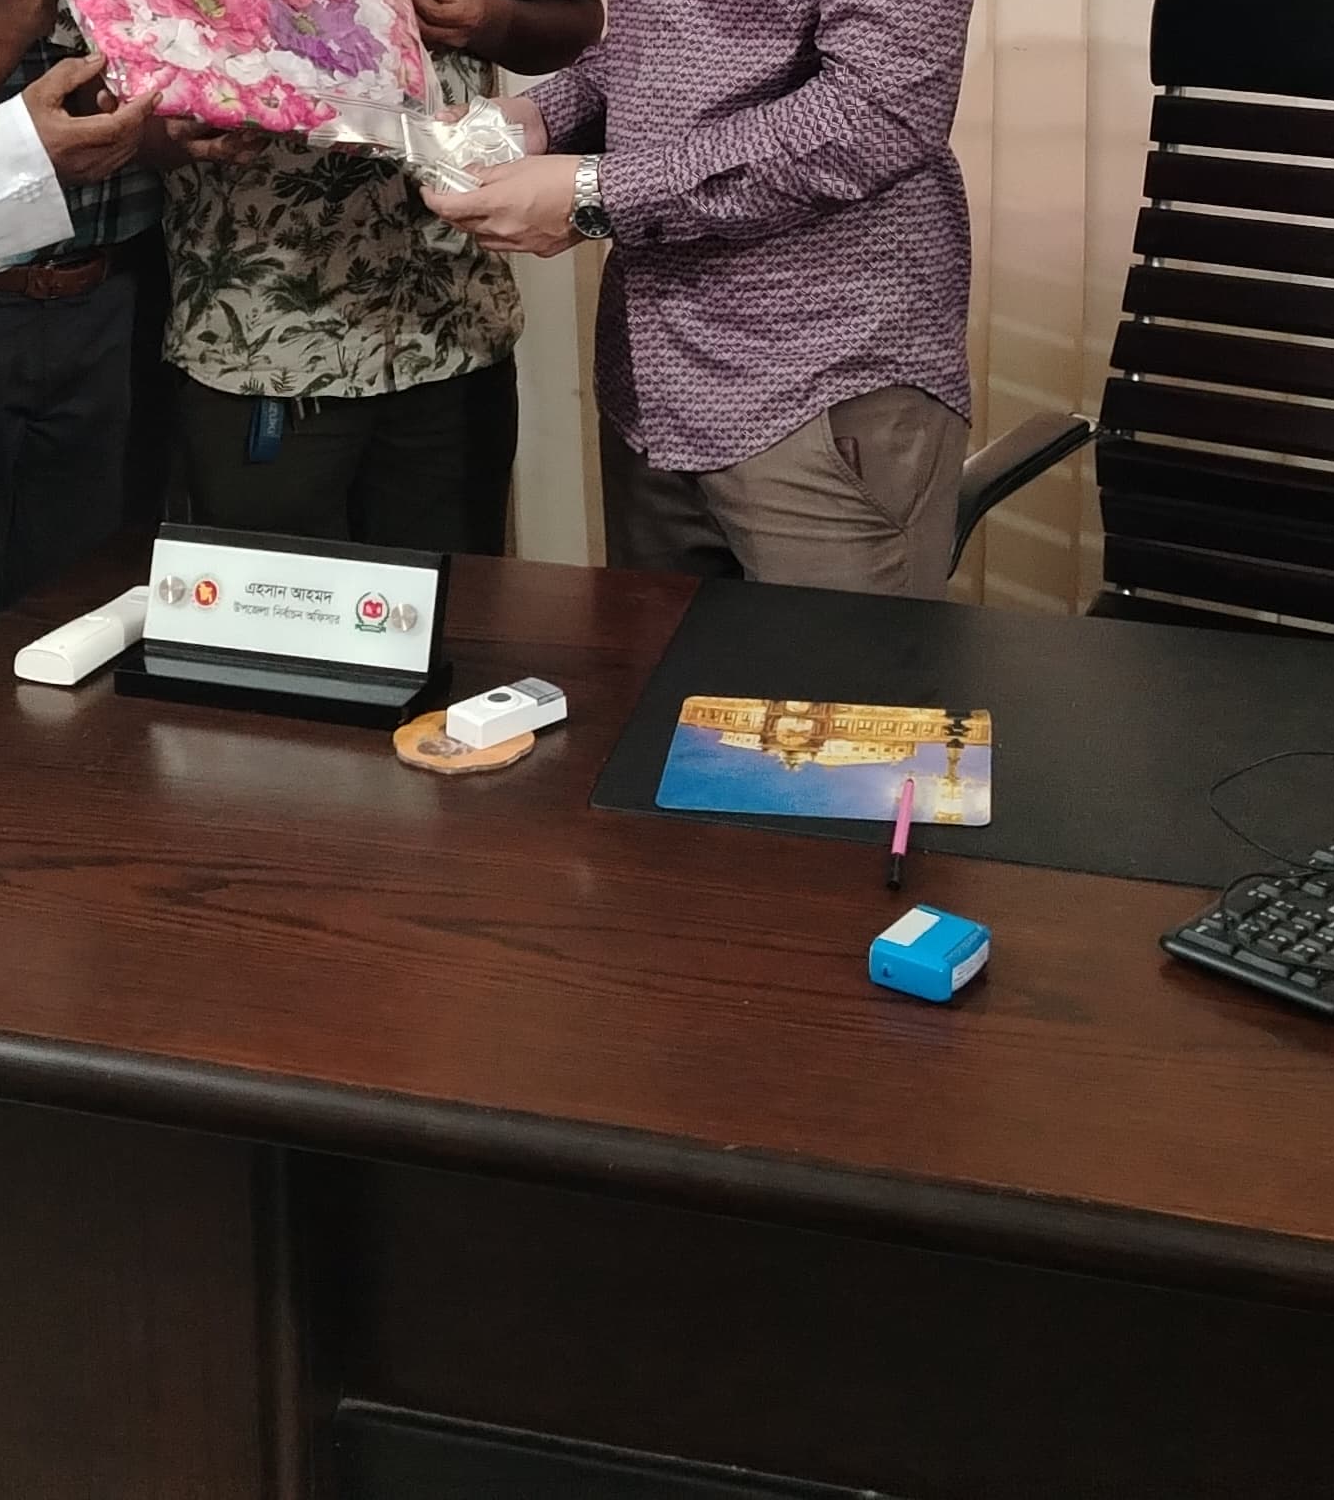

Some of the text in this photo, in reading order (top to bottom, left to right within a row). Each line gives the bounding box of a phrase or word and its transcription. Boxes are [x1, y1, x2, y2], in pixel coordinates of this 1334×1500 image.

[245, 582, 335, 604] এহসান আহমদ
[233, 601, 270, 616] উপজেলা
[273, 603, 303, 619] নির্বাচন
